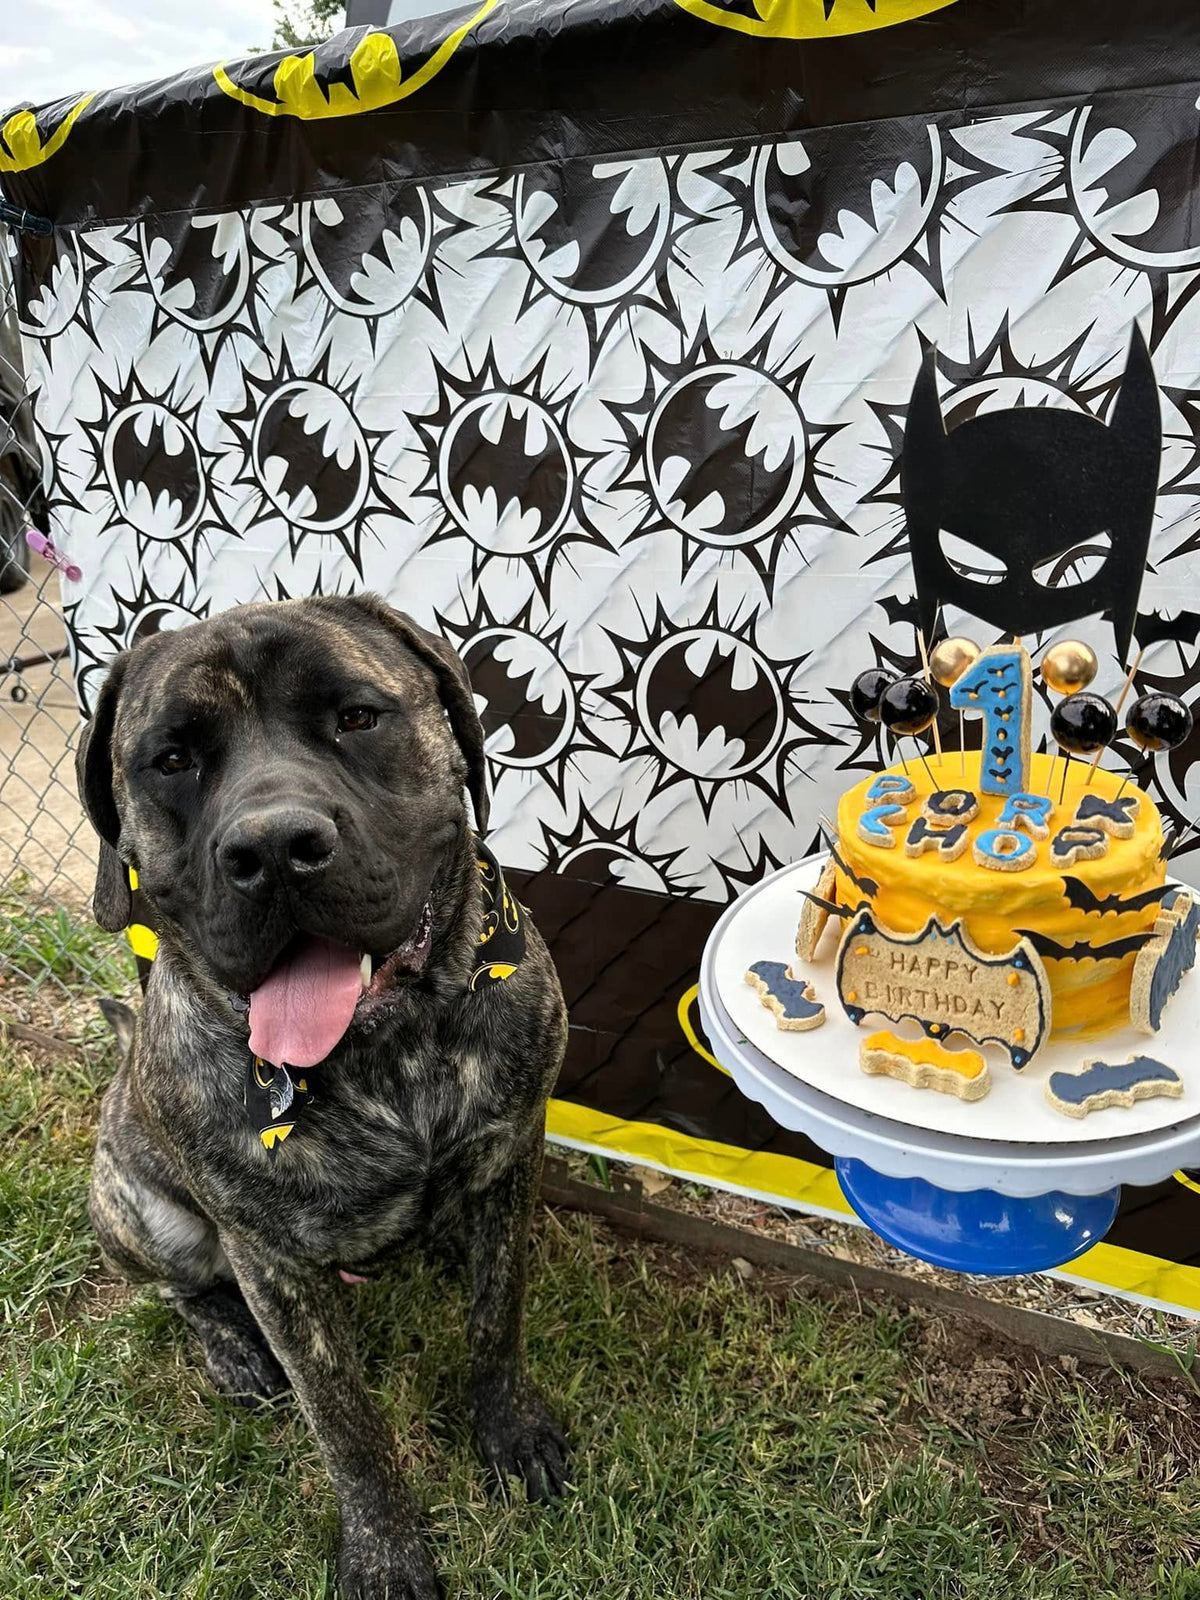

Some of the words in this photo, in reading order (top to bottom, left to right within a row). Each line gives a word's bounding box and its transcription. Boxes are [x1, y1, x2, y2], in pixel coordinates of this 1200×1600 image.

[950, 644, 1032, 797] 1
[857, 803, 1110, 872] CHOP
[865, 775, 1141, 839] PORK
[889, 950, 978, 984] HAPPY
[863, 980, 1006, 1020] BIRTHDAY
